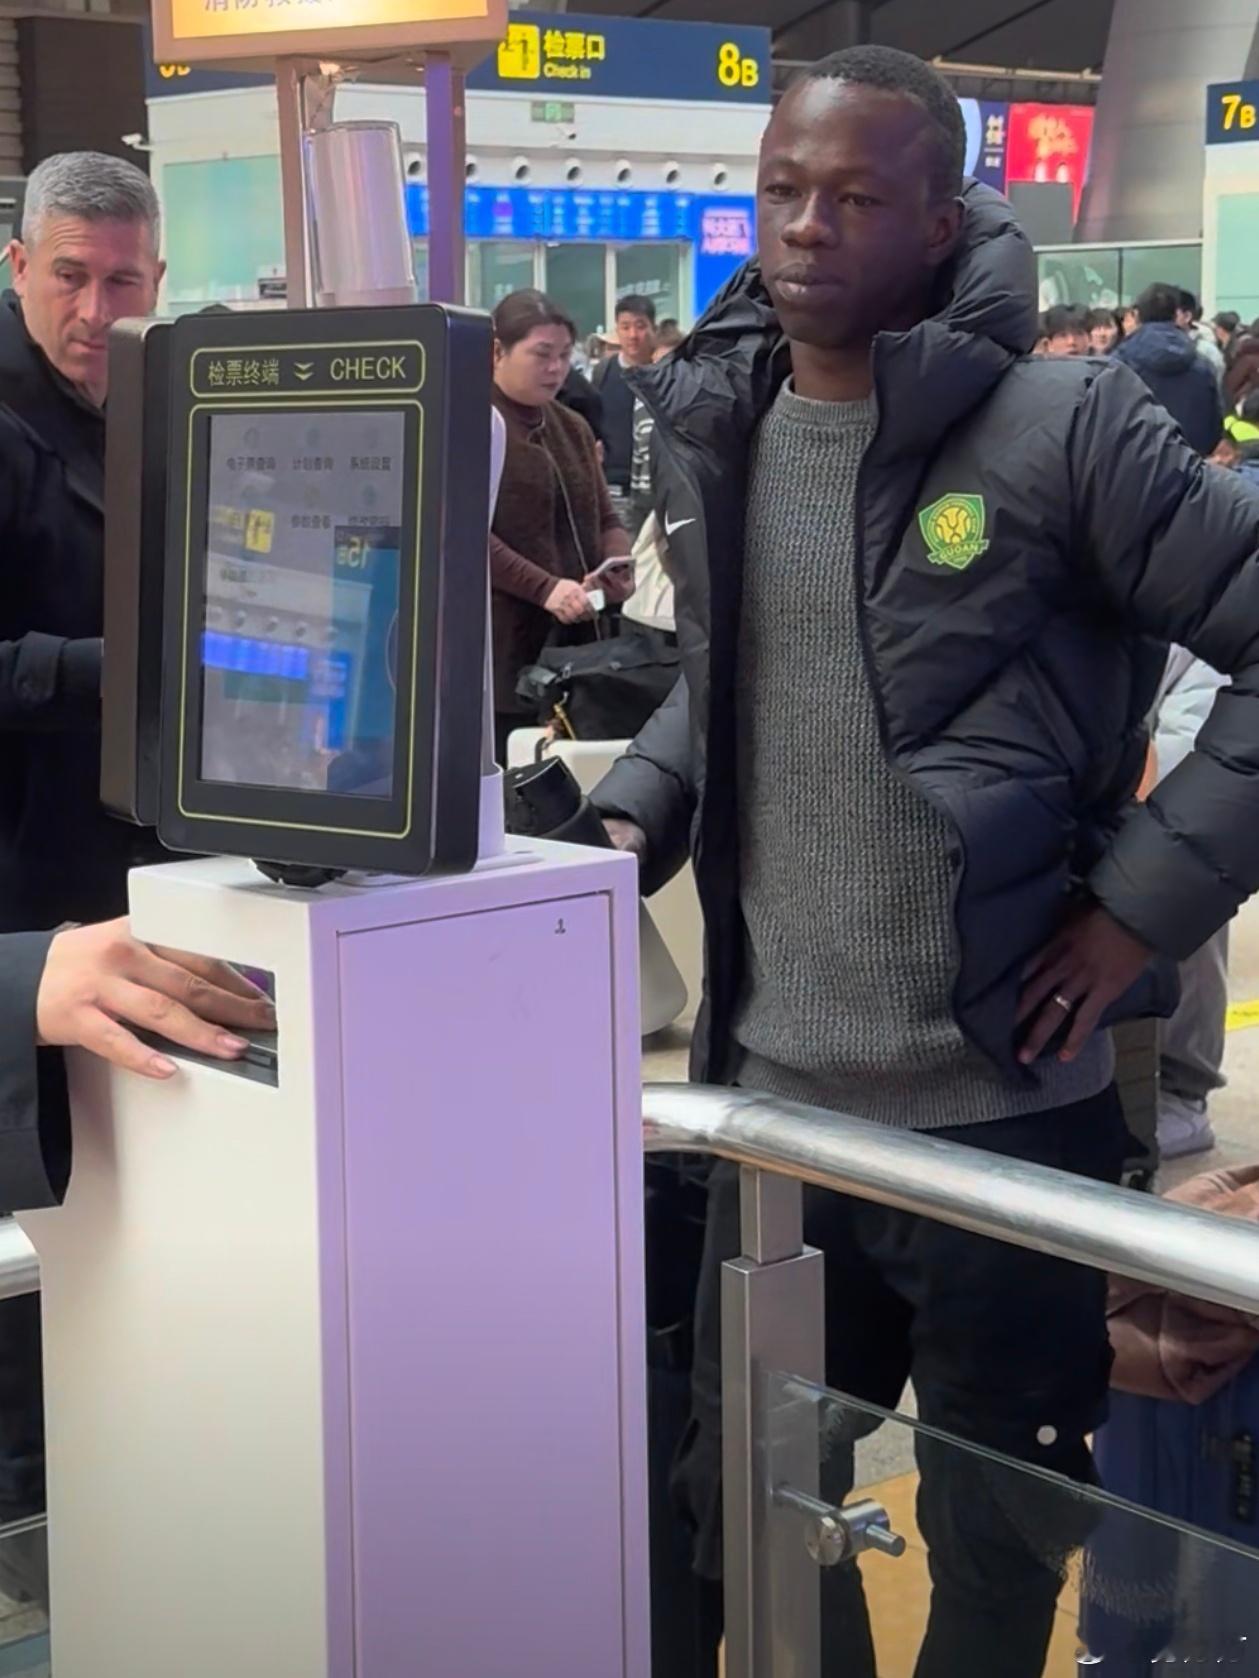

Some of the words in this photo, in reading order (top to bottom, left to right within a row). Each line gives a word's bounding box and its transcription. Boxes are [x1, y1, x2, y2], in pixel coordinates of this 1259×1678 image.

[544, 30, 605, 60] 检票口
[544, 62, 578, 78] Check
[718, 43, 759, 87] 8B
[1221, 95, 1256, 129] 7B
[207, 358, 280, 386] 检票终端
[330, 356, 407, 381] CHECK
